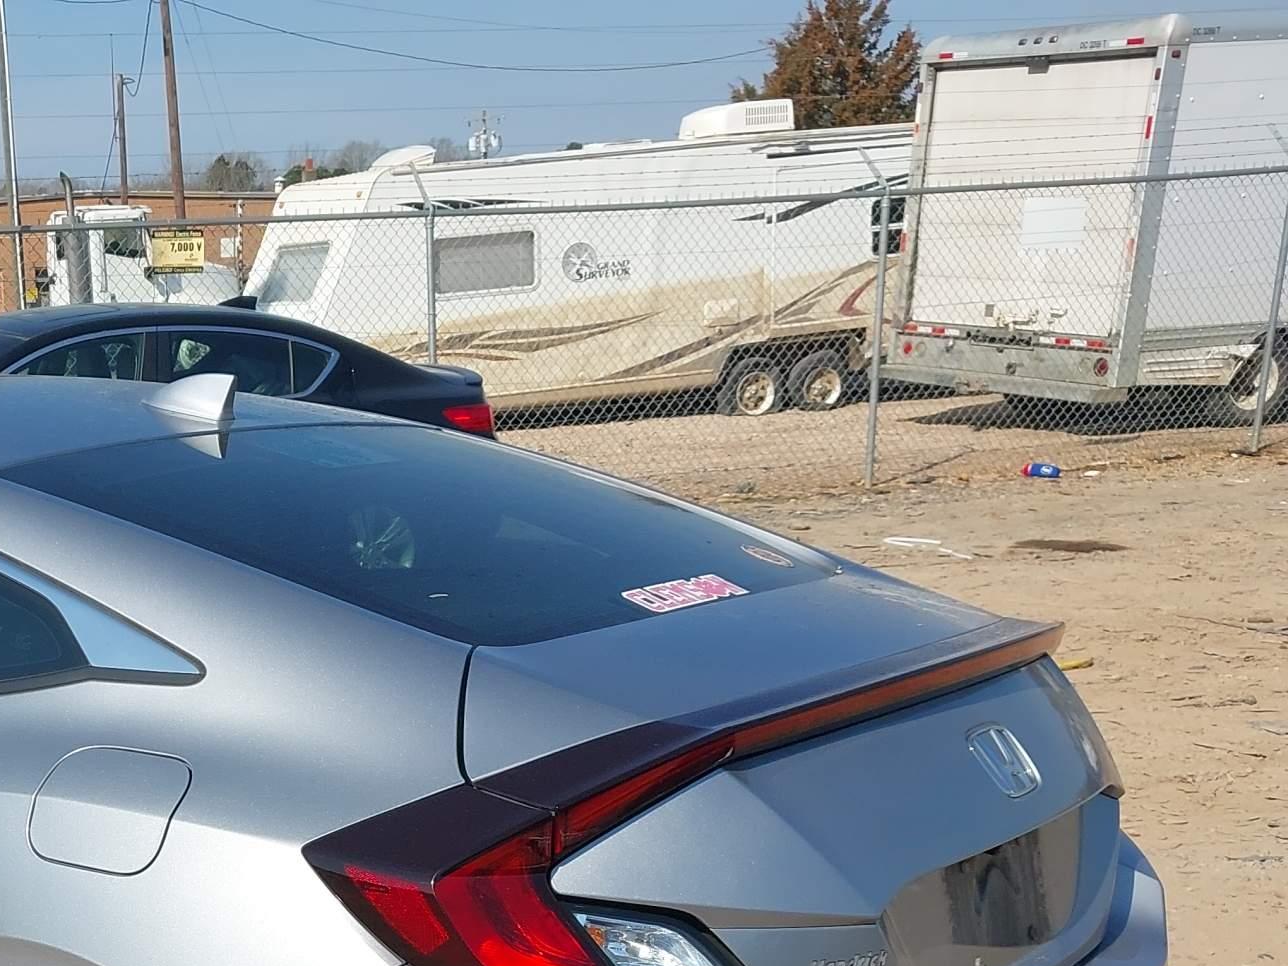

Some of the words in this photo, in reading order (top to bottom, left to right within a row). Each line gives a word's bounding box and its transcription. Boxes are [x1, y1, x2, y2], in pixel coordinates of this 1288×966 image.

[170, 242, 194, 253] 7,000
[196, 242, 202, 251] V
[596, 259, 631, 270] GRAND
[575, 266, 631, 281] SURVEYOR
